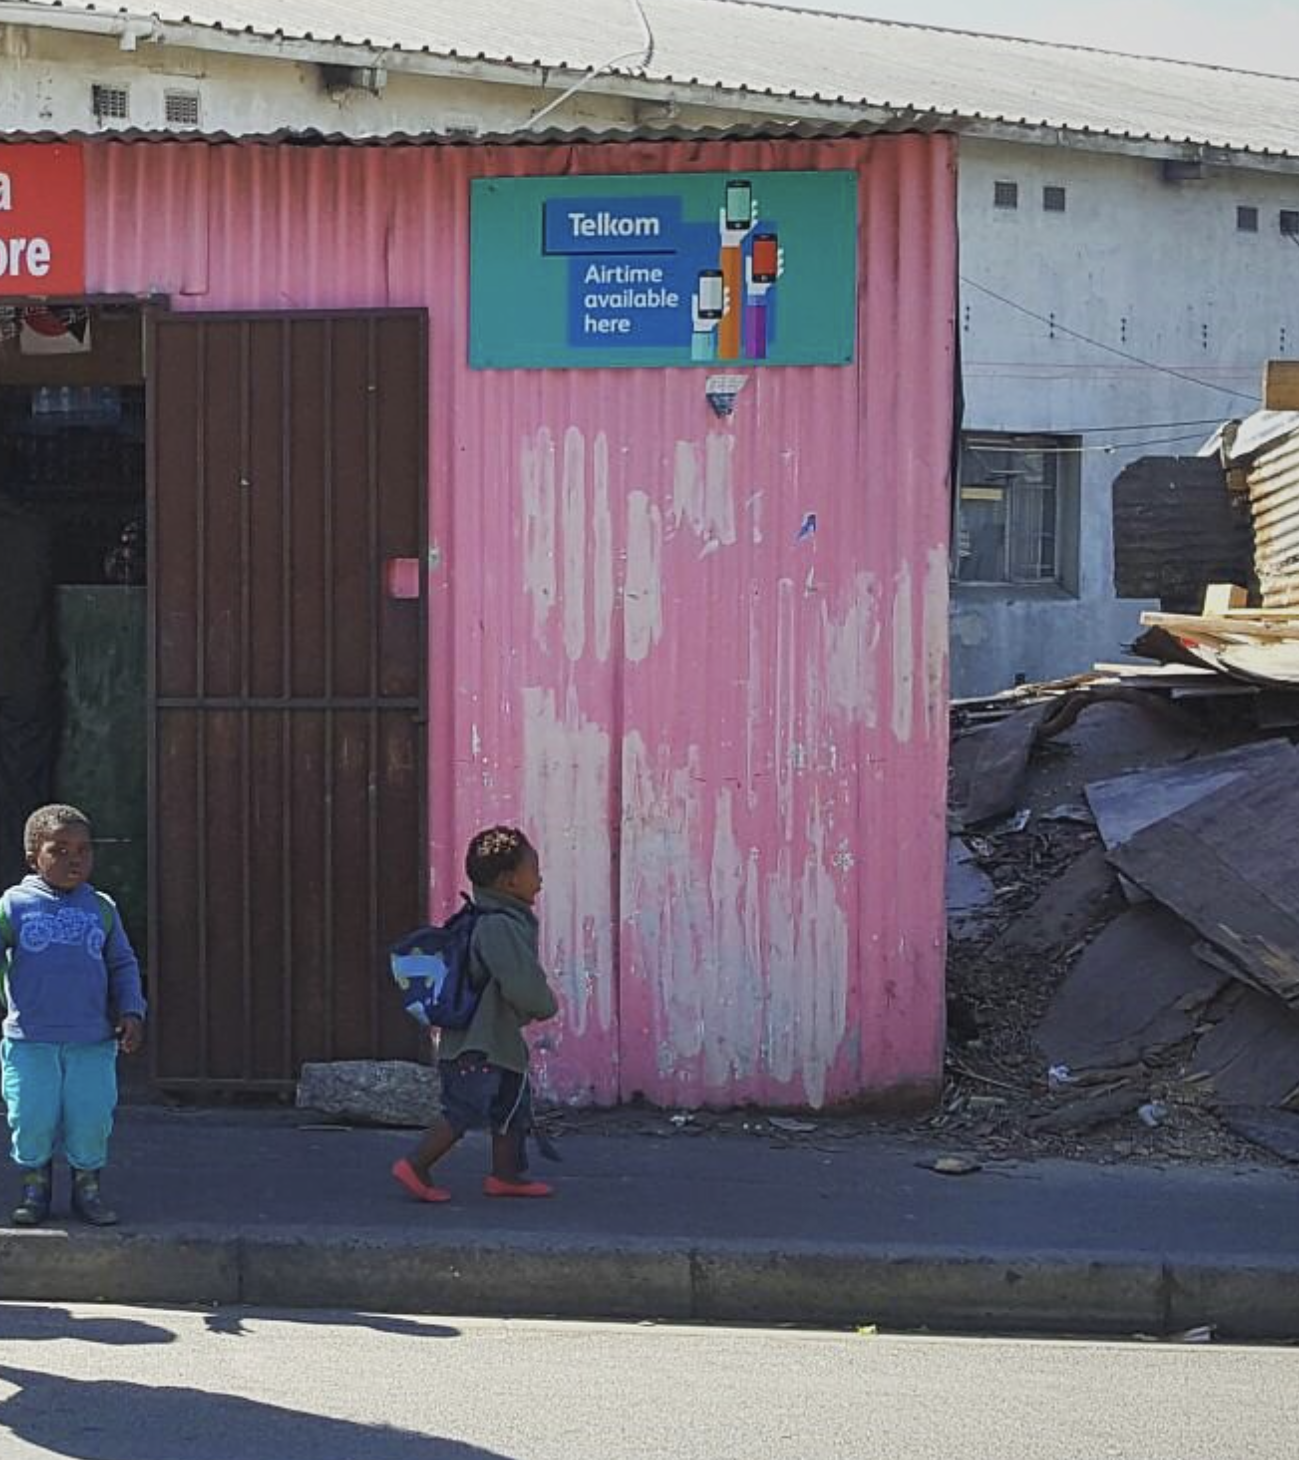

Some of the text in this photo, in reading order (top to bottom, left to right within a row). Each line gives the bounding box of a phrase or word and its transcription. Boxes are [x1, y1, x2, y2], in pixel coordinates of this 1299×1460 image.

[568, 212, 660, 237] Telkom
[584, 264, 663, 285] Airtime
[584, 289, 679, 308] available
[584, 315, 631, 333] here
